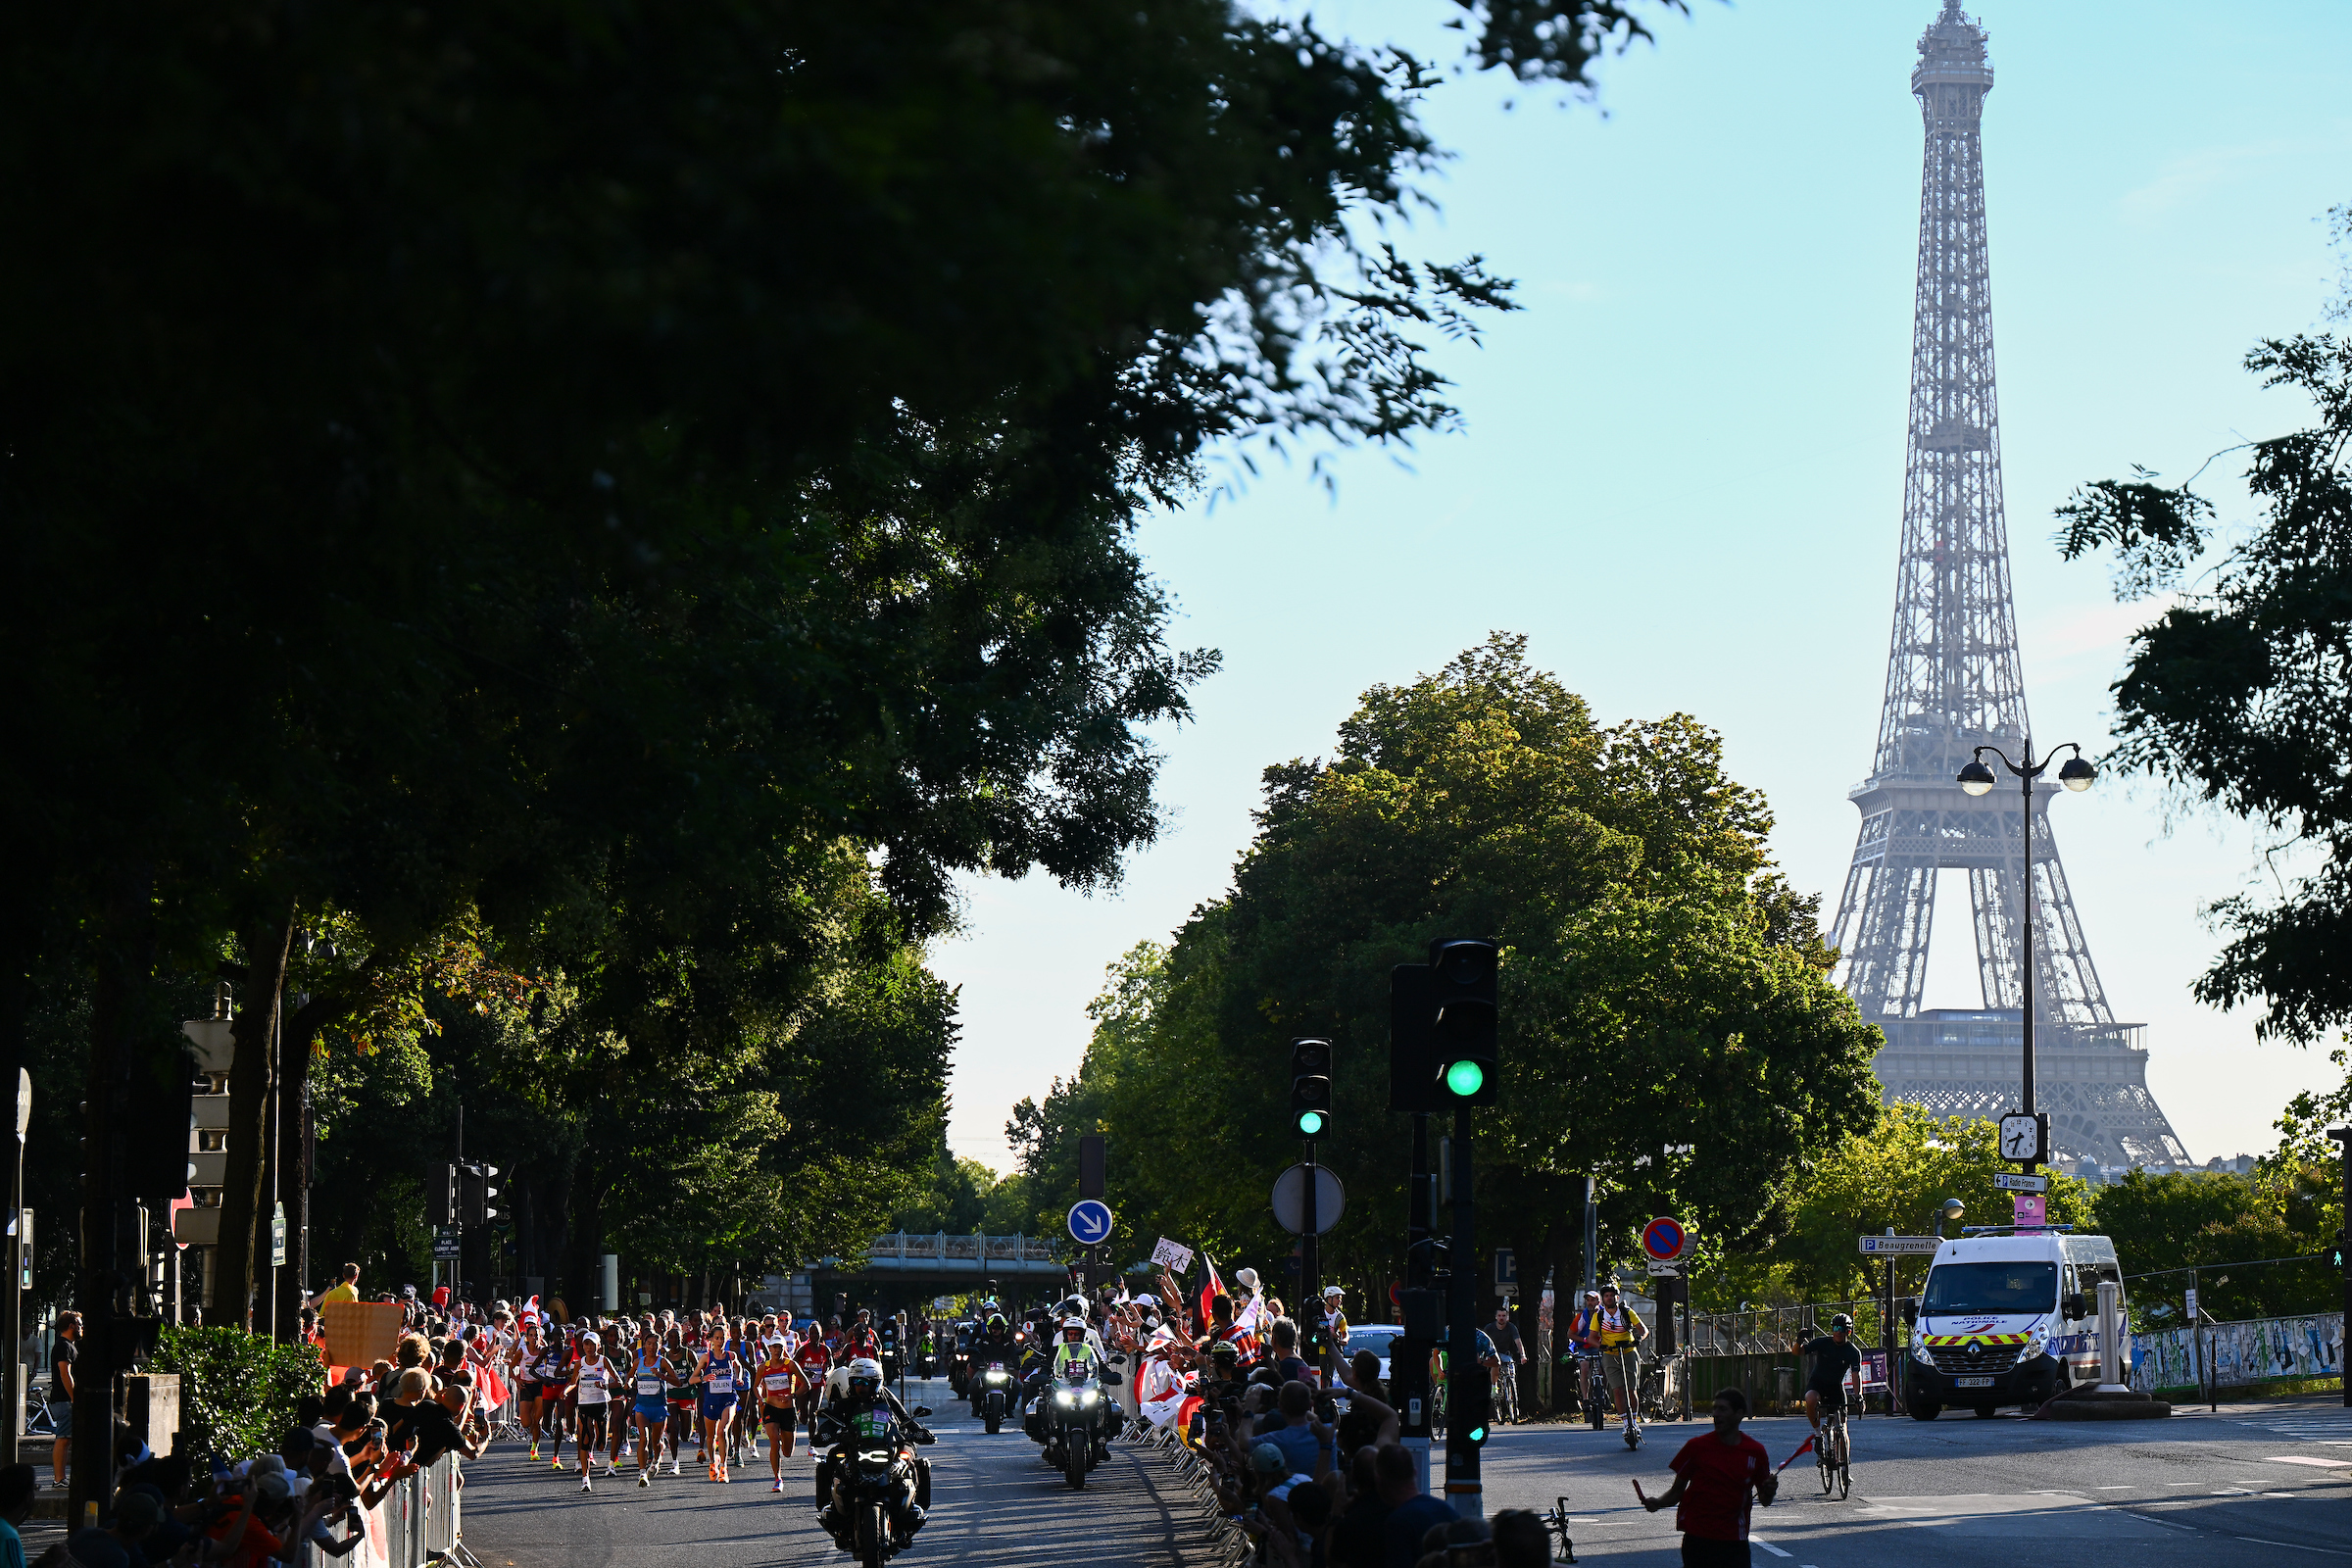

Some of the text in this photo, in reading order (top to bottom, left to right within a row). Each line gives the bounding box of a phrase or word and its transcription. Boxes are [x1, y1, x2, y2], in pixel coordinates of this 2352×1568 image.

[18, 1090, 29, 1105] AXI
[2010, 1178, 2021, 1187] Radio
[2022, 1178, 2035, 1189] France
[1867, 1240, 1936, 1250] P Beaugrenelle
